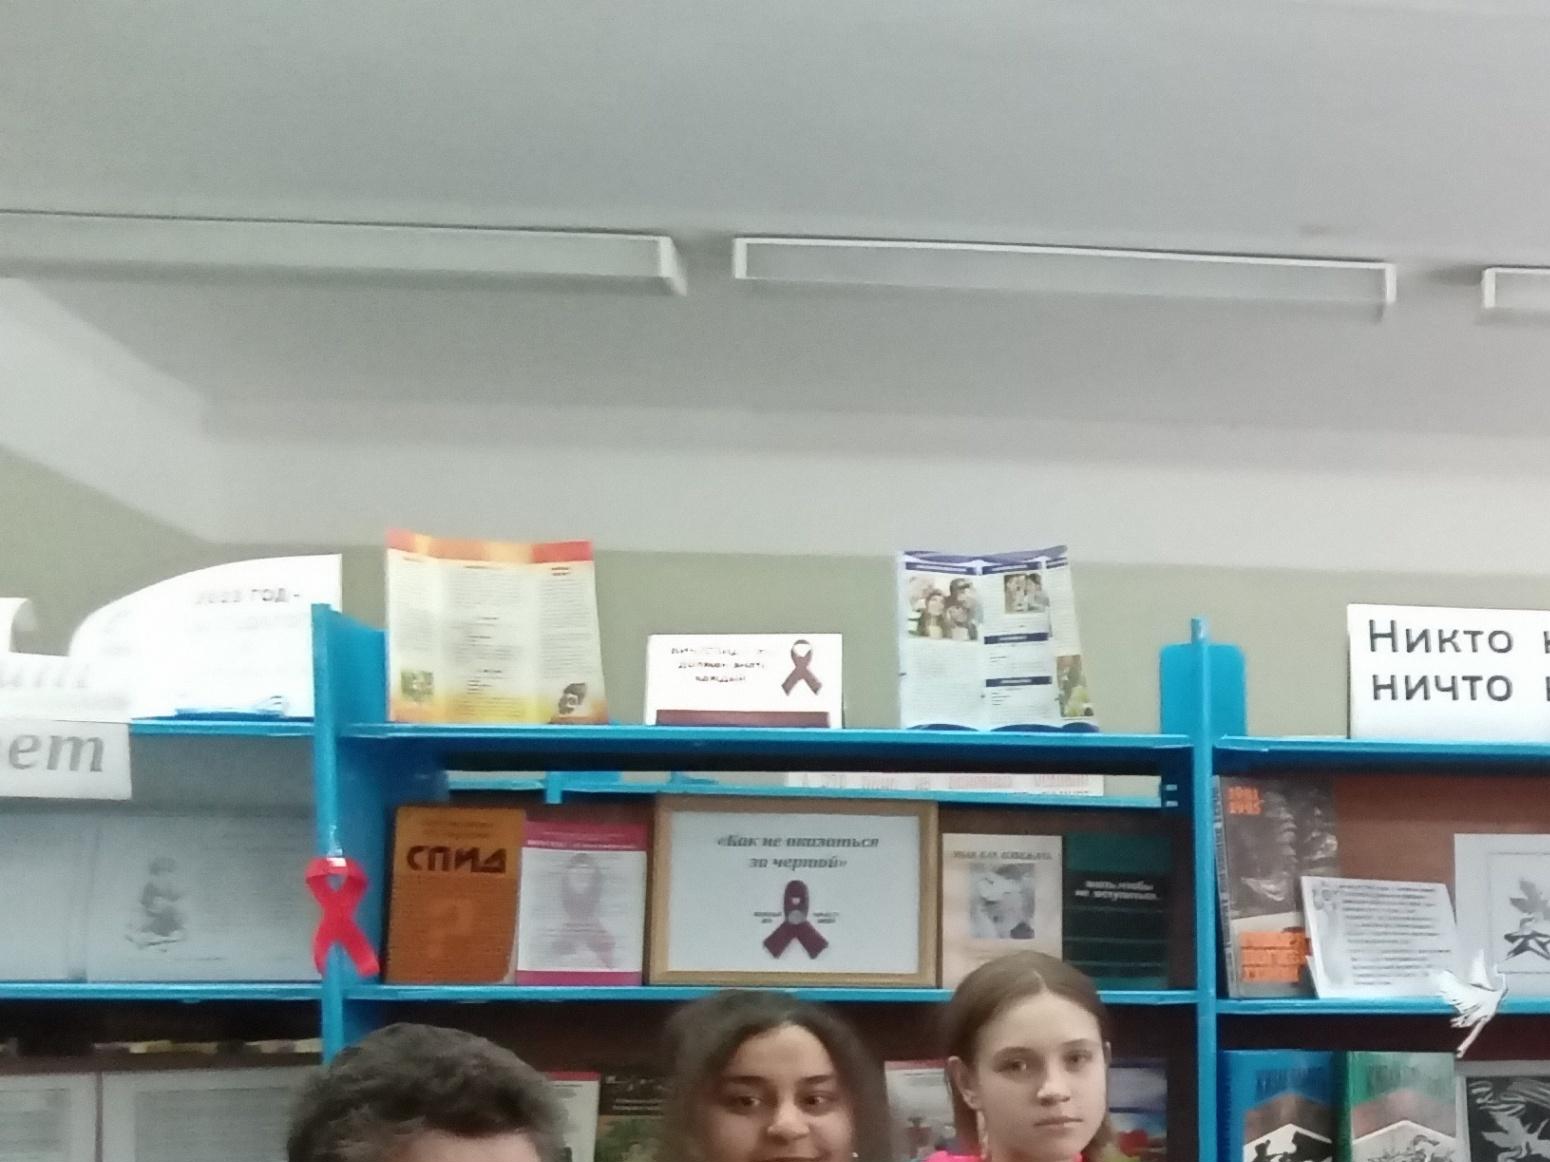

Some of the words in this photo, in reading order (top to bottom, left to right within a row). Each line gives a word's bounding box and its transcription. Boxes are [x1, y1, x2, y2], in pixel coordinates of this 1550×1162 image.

[1368, 619, 1513, 655] Никто
[1371, 673, 1513, 701] ничто
[762, 836, 783, 848] не
[405, 844, 508, 873] СПИД
